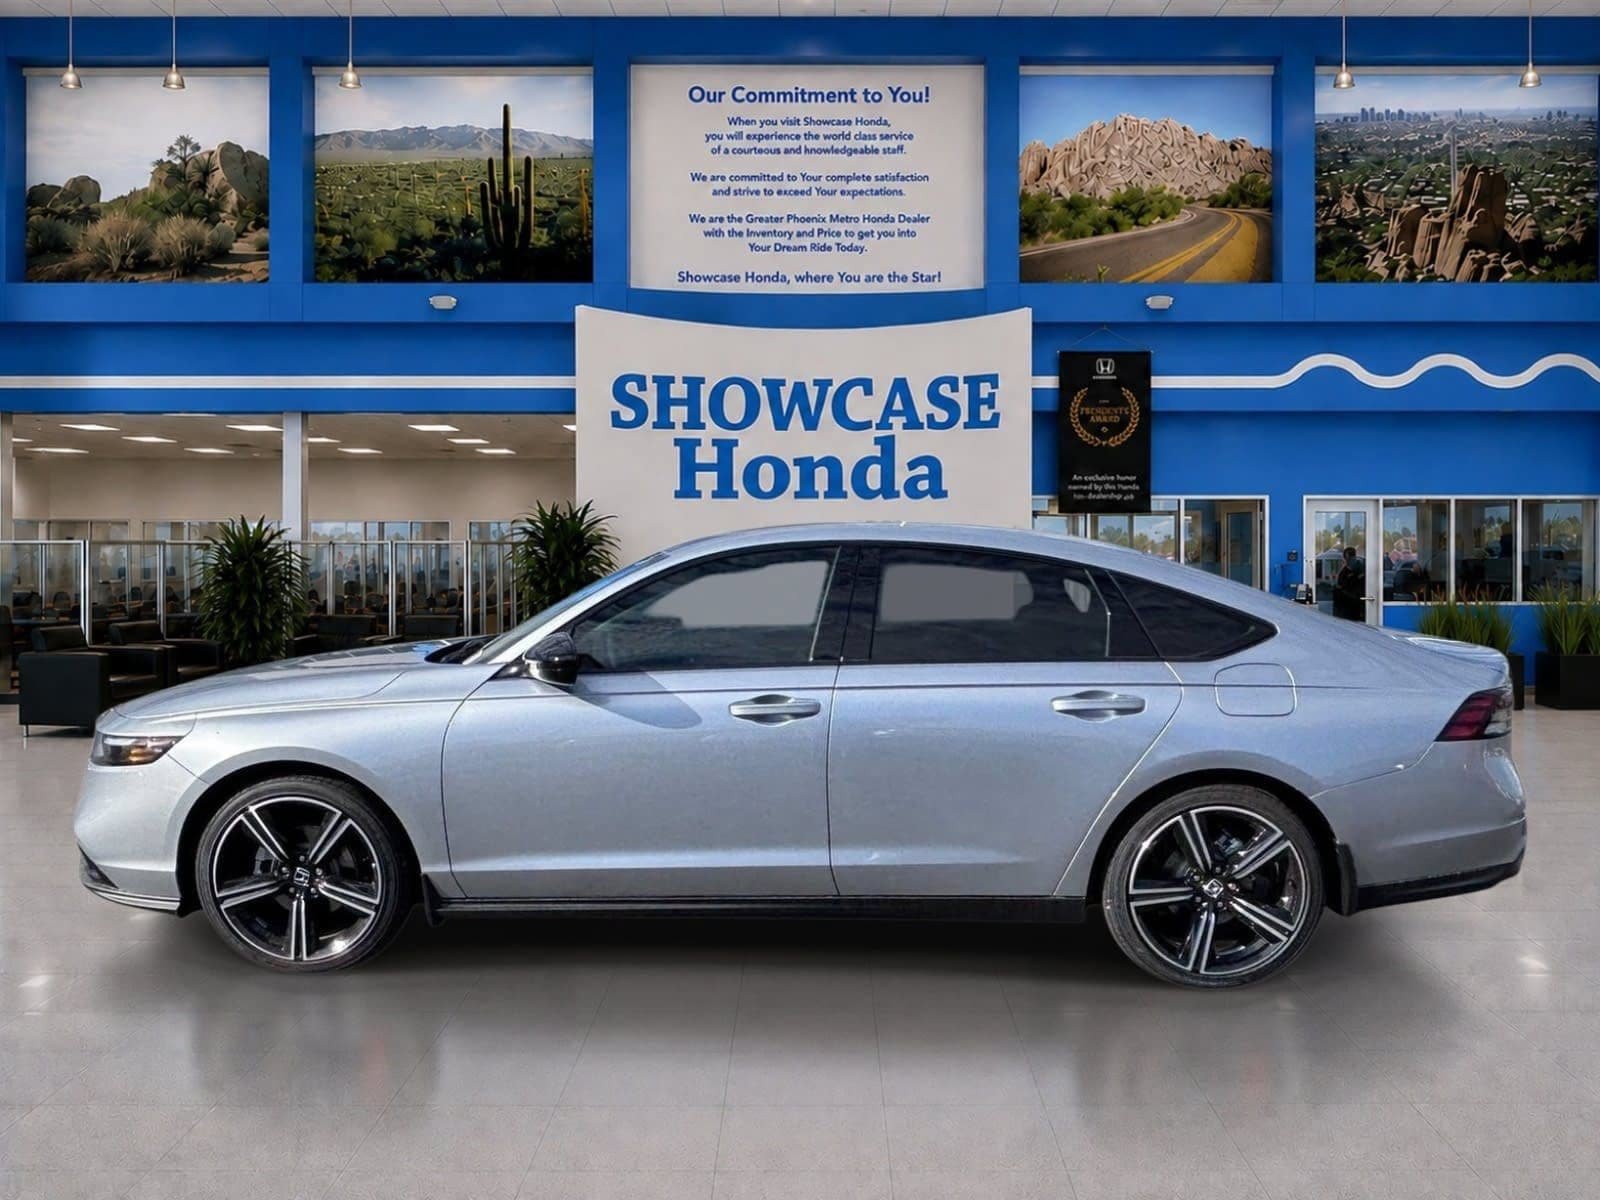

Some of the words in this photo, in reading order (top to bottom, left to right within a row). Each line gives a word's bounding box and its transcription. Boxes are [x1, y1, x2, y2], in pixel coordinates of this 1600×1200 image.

[687, 85, 727, 104] Our
[730, 84, 858, 104] Commitment
[861, 87, 884, 105] to
[886, 85, 931, 104] You!
[726, 115, 758, 127] When
[758, 118, 779, 129] you
[779, 116, 802, 127] visit
[802, 115, 853, 127] Showcase
[854, 116, 892, 128] Honda,
[704, 132, 724, 144] you
[725, 130, 744, 141] will
[745, 130, 802, 144] experience
[802, 130, 821, 142] the
[822, 130, 852, 142] world
[853, 130, 878, 142] class
[878, 130, 915, 142] service
[710, 143, 722, 156] of
[722, 146, 730, 156] a
[730, 146, 782, 156] courteous
[783, 144, 803, 156] and
[689, 172, 708, 183] We
[709, 174, 727, 183] are
[728, 171, 785, 183] committed
[786, 173, 798, 183] to
[799, 171, 823, 183] Your
[824, 171, 873, 185] complete
[873, 171, 930, 183] satisfaction
[711, 185, 732, 197] and
[732, 185, 761, 197] strive
[762, 187, 775, 197] to
[775, 185, 813, 197] exceed
[814, 185, 838, 197] Your
[688, 213, 707, 224] We
[707, 215, 726, 225] are
[726, 213, 744, 224] the
[744, 213, 785, 224] Greater
[786, 213, 827, 224] Phoenix
[828, 213, 861, 224] Metro
[862, 213, 896, 224] Honda
[897, 213, 931, 224] Dealer
[702, 227, 726, 239] with
[727, 227, 745, 239] the
[745, 227, 795, 241] Inventory
[795, 227, 815, 239] and
[816, 227, 842, 239] Price
[843, 229, 856, 239] to
[856, 229, 875, 241] get
[876, 229, 896, 241] you
[896, 227, 917, 239] into
[747, 242, 772, 253] Your
[773, 242, 808, 253] Dream
[809, 242, 833, 253] Ride
[834, 241, 869, 255] Today.
[677, 270, 742, 284] Showcase
[744, 270, 791, 286] Honda,
[793, 270, 835, 284] where
[836, 271, 861, 284] You
[863, 273, 885, 284] are
[886, 270, 909, 284] the
[911, 270, 942, 284] Star!
[610, 373, 1001, 431] SHOWCASE
[673, 434, 949, 500] Honda
